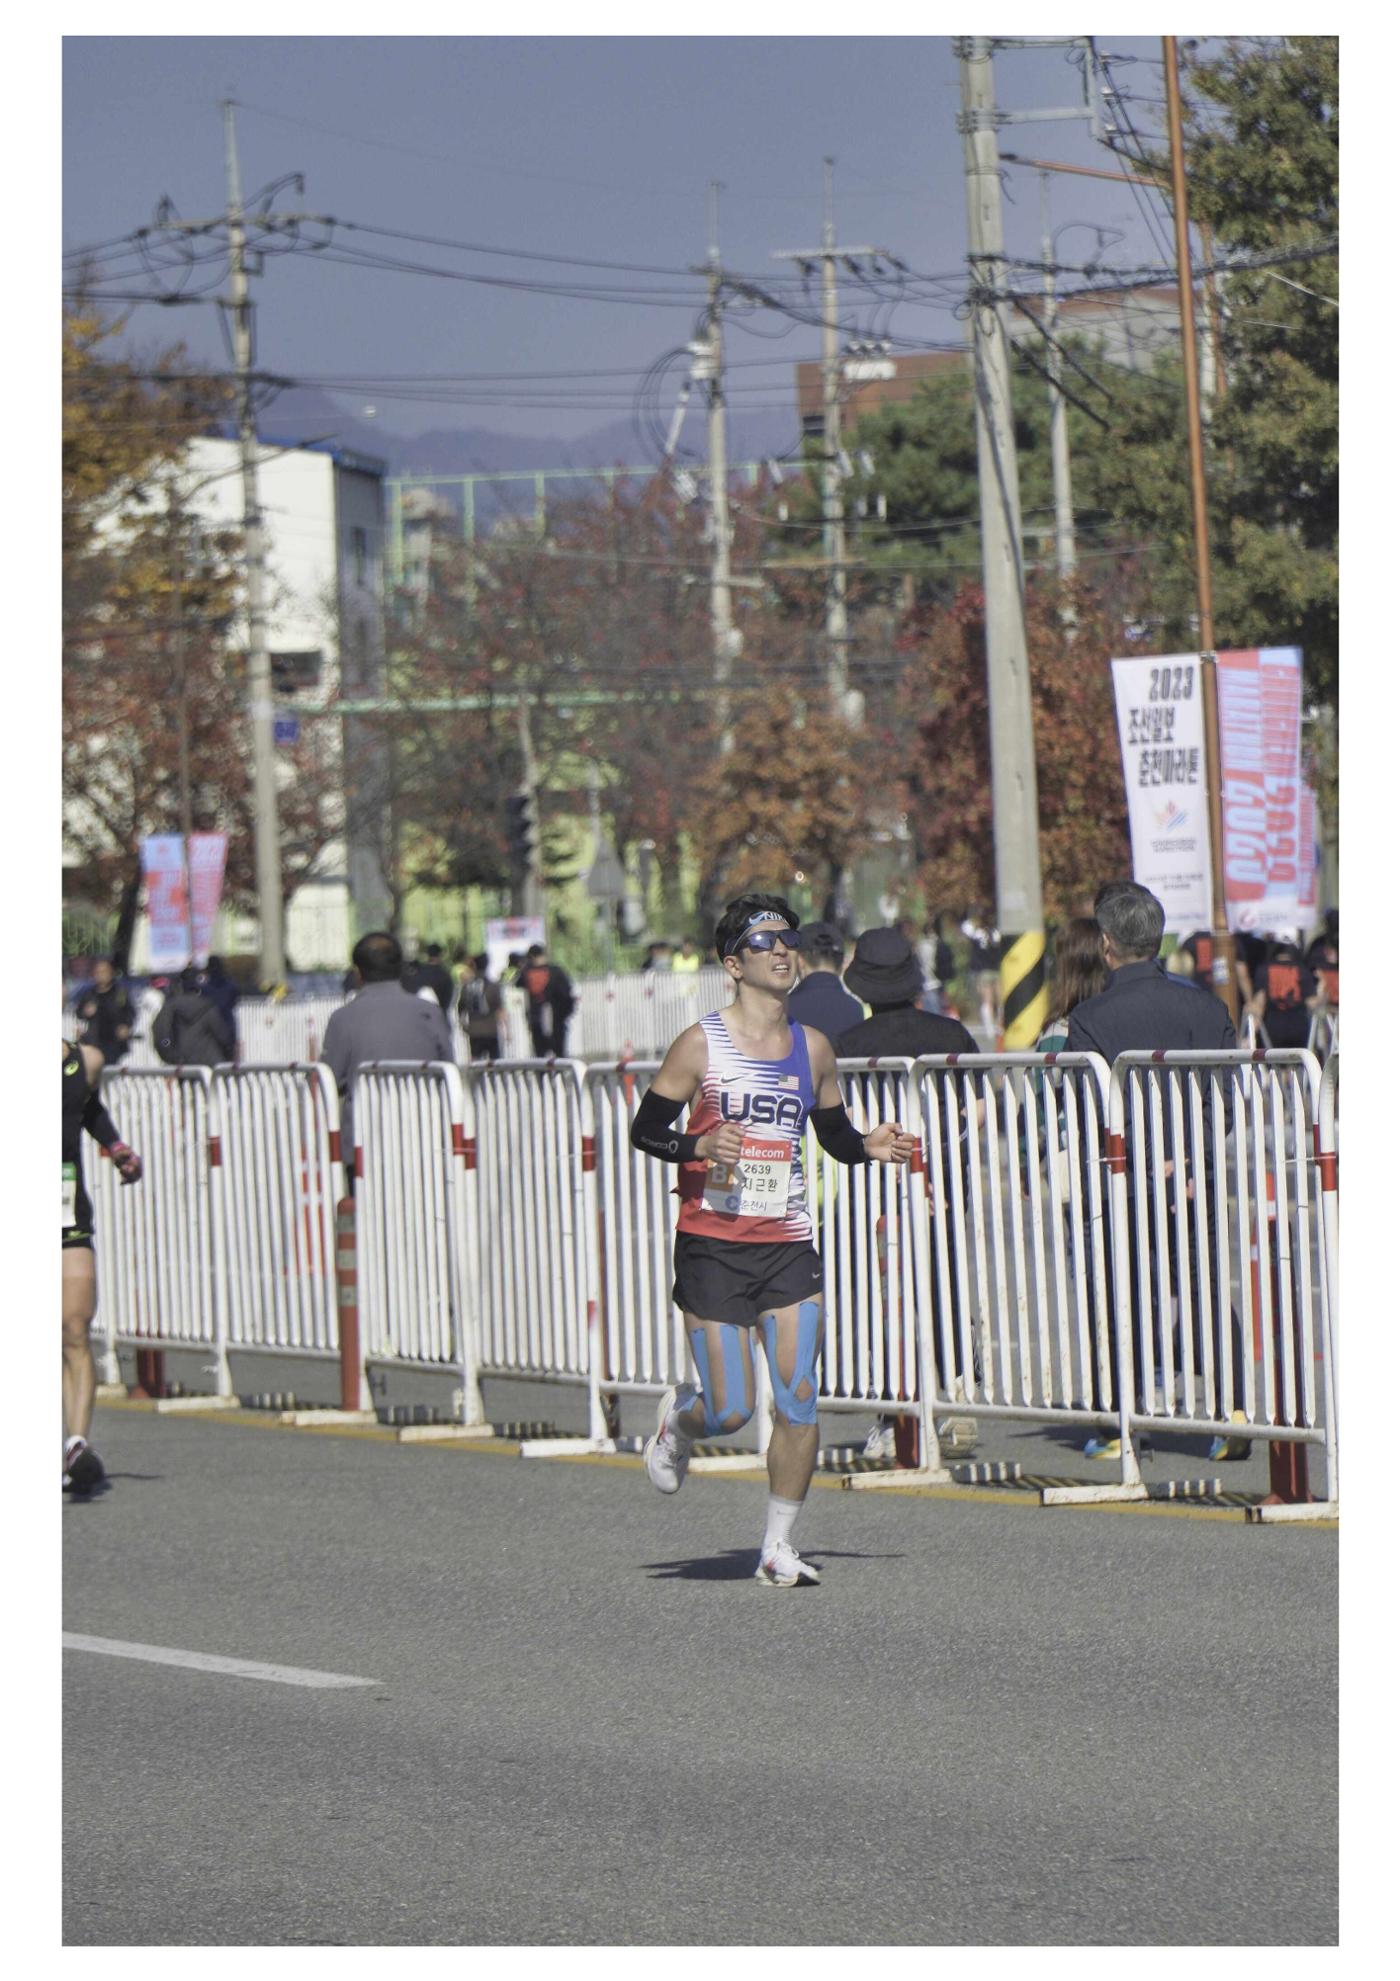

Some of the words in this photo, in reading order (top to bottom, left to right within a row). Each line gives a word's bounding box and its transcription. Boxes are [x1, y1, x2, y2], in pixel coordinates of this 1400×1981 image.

[1149, 666, 1194, 700] 2023
[1128, 706, 1175, 744] 조선일보
[1139, 747, 1199, 786] 춘천마라톤
[720, 1091, 803, 1130] USA
[741, 1145, 785, 1159] telecom
[744, 1164, 772, 1175] 2639
